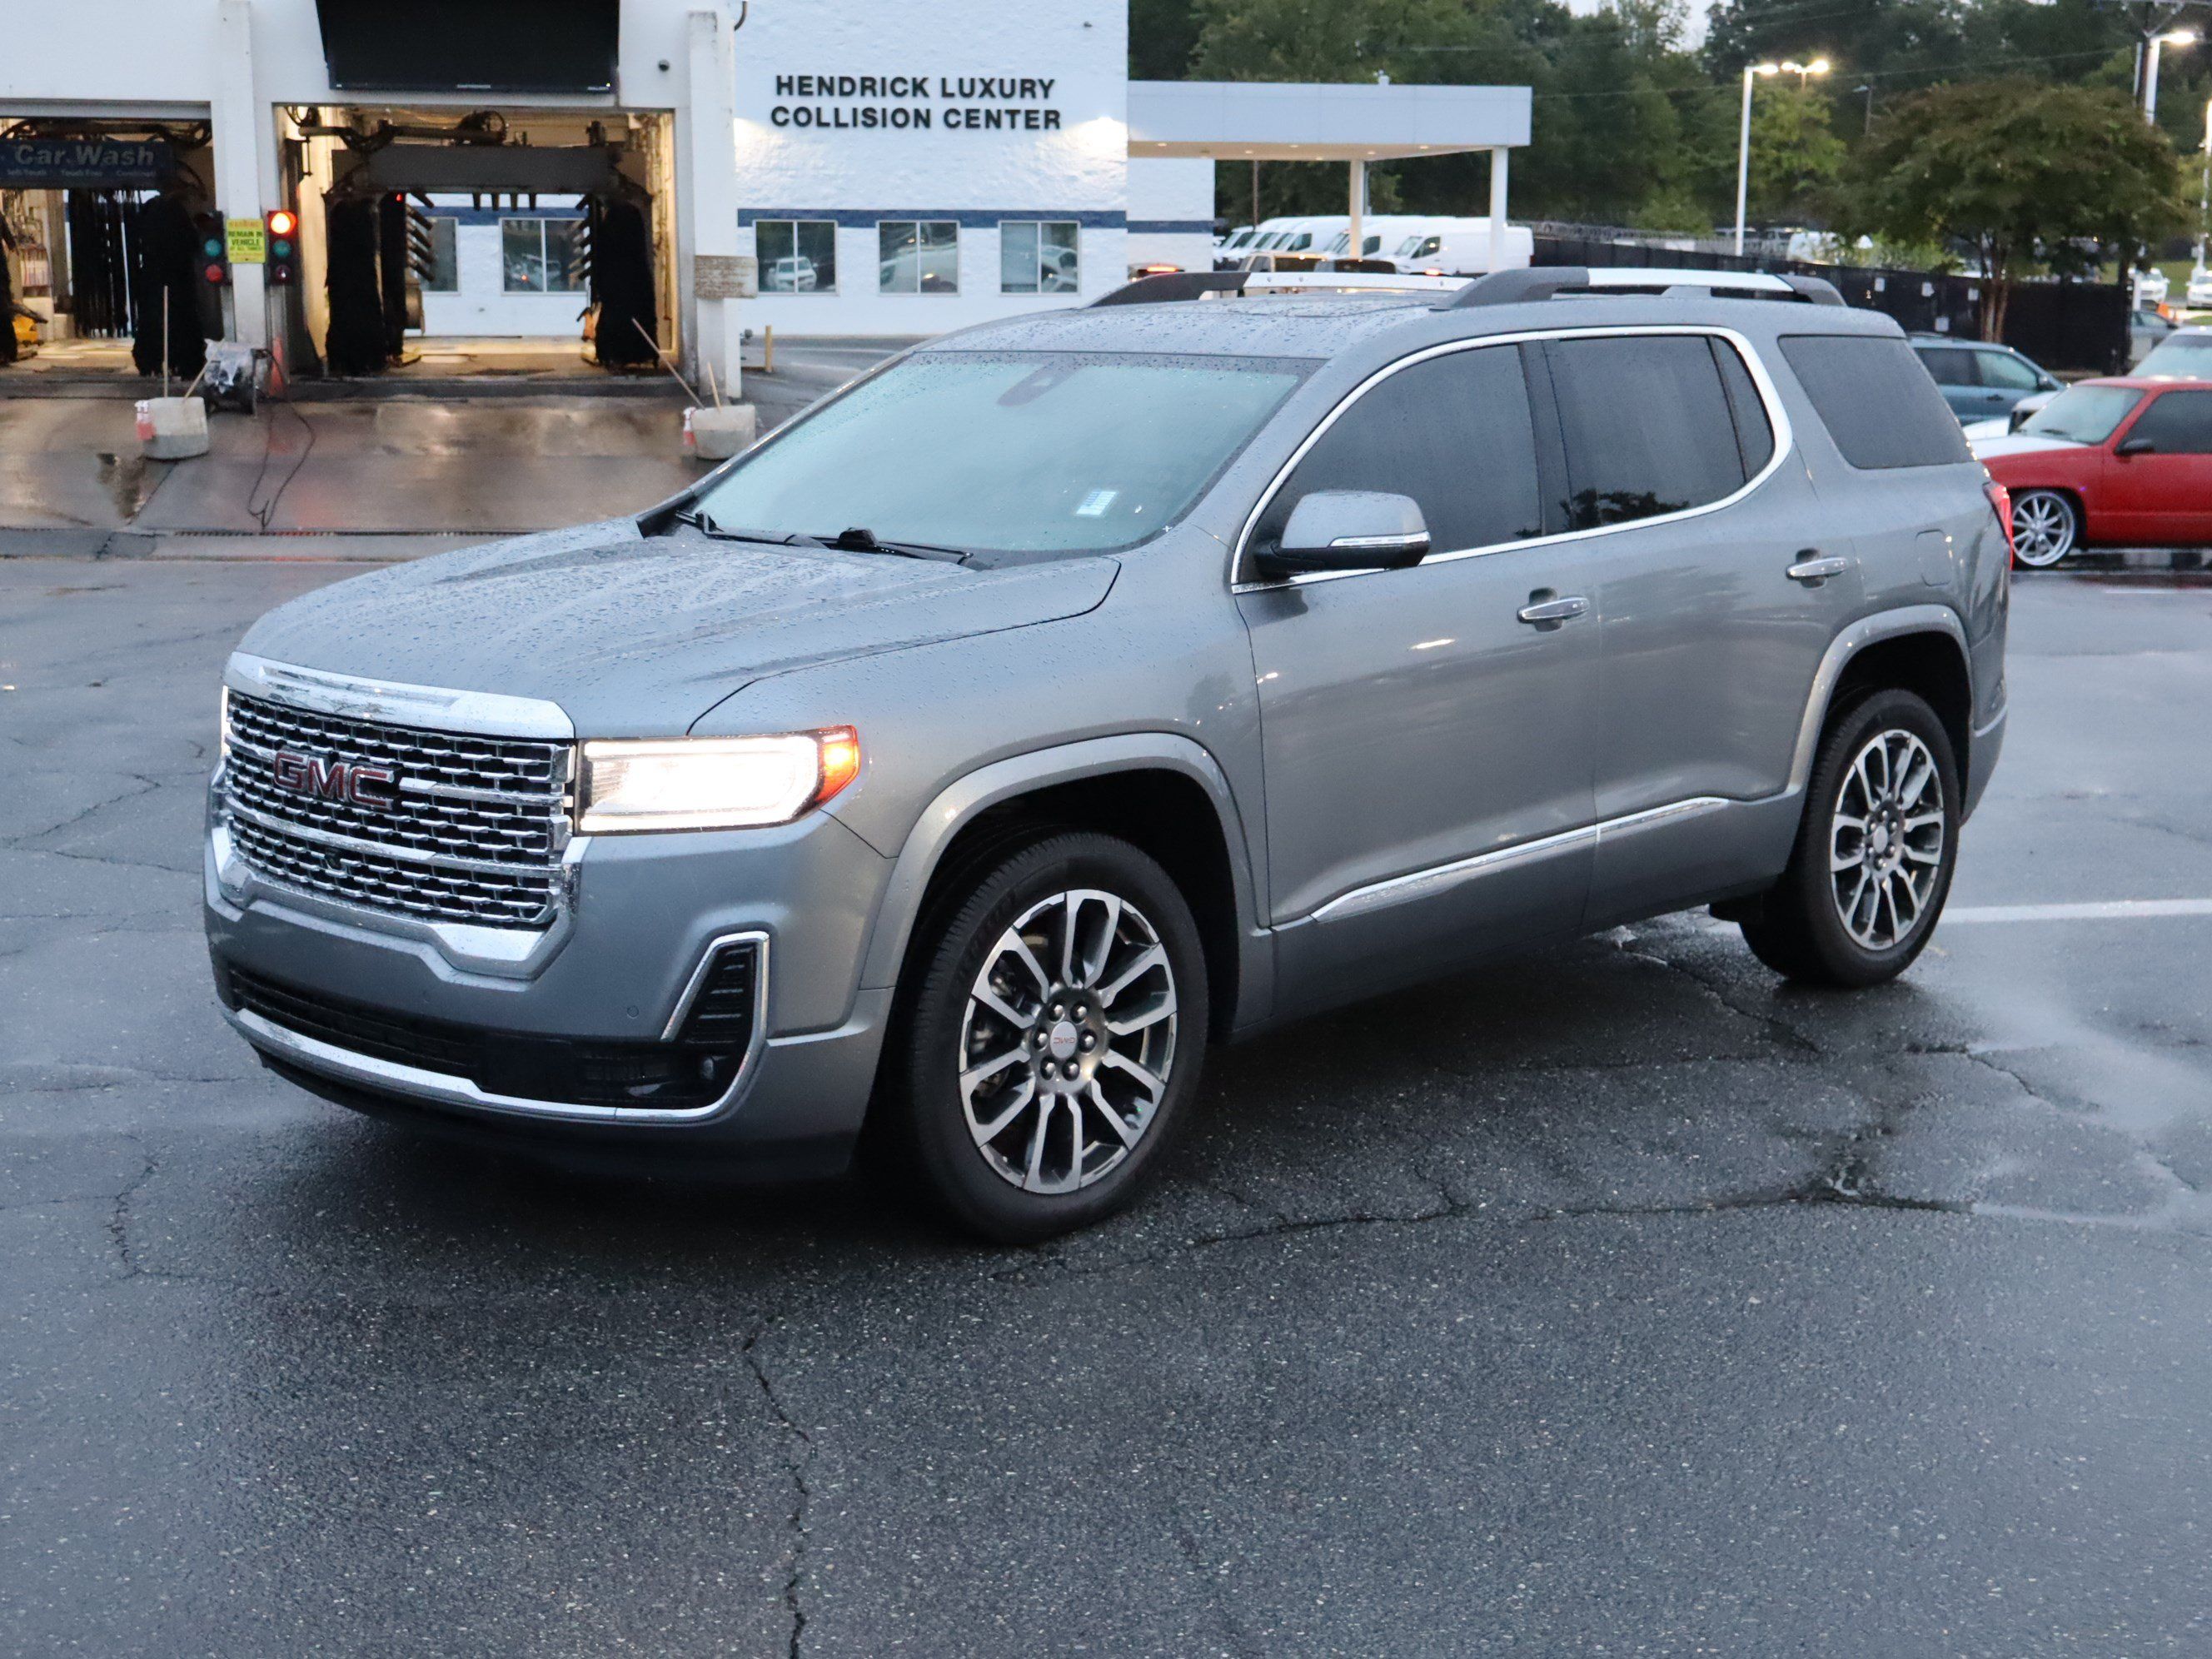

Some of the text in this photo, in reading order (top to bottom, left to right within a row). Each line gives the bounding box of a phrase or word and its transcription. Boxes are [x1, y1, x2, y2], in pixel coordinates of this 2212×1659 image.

[776, 75, 1055, 99] HENDRICK LUXURY
[770, 106, 1061, 130] COLLISION CENTER
[15, 144, 154, 166] Car Wash
[274, 750, 394, 811] GMC
